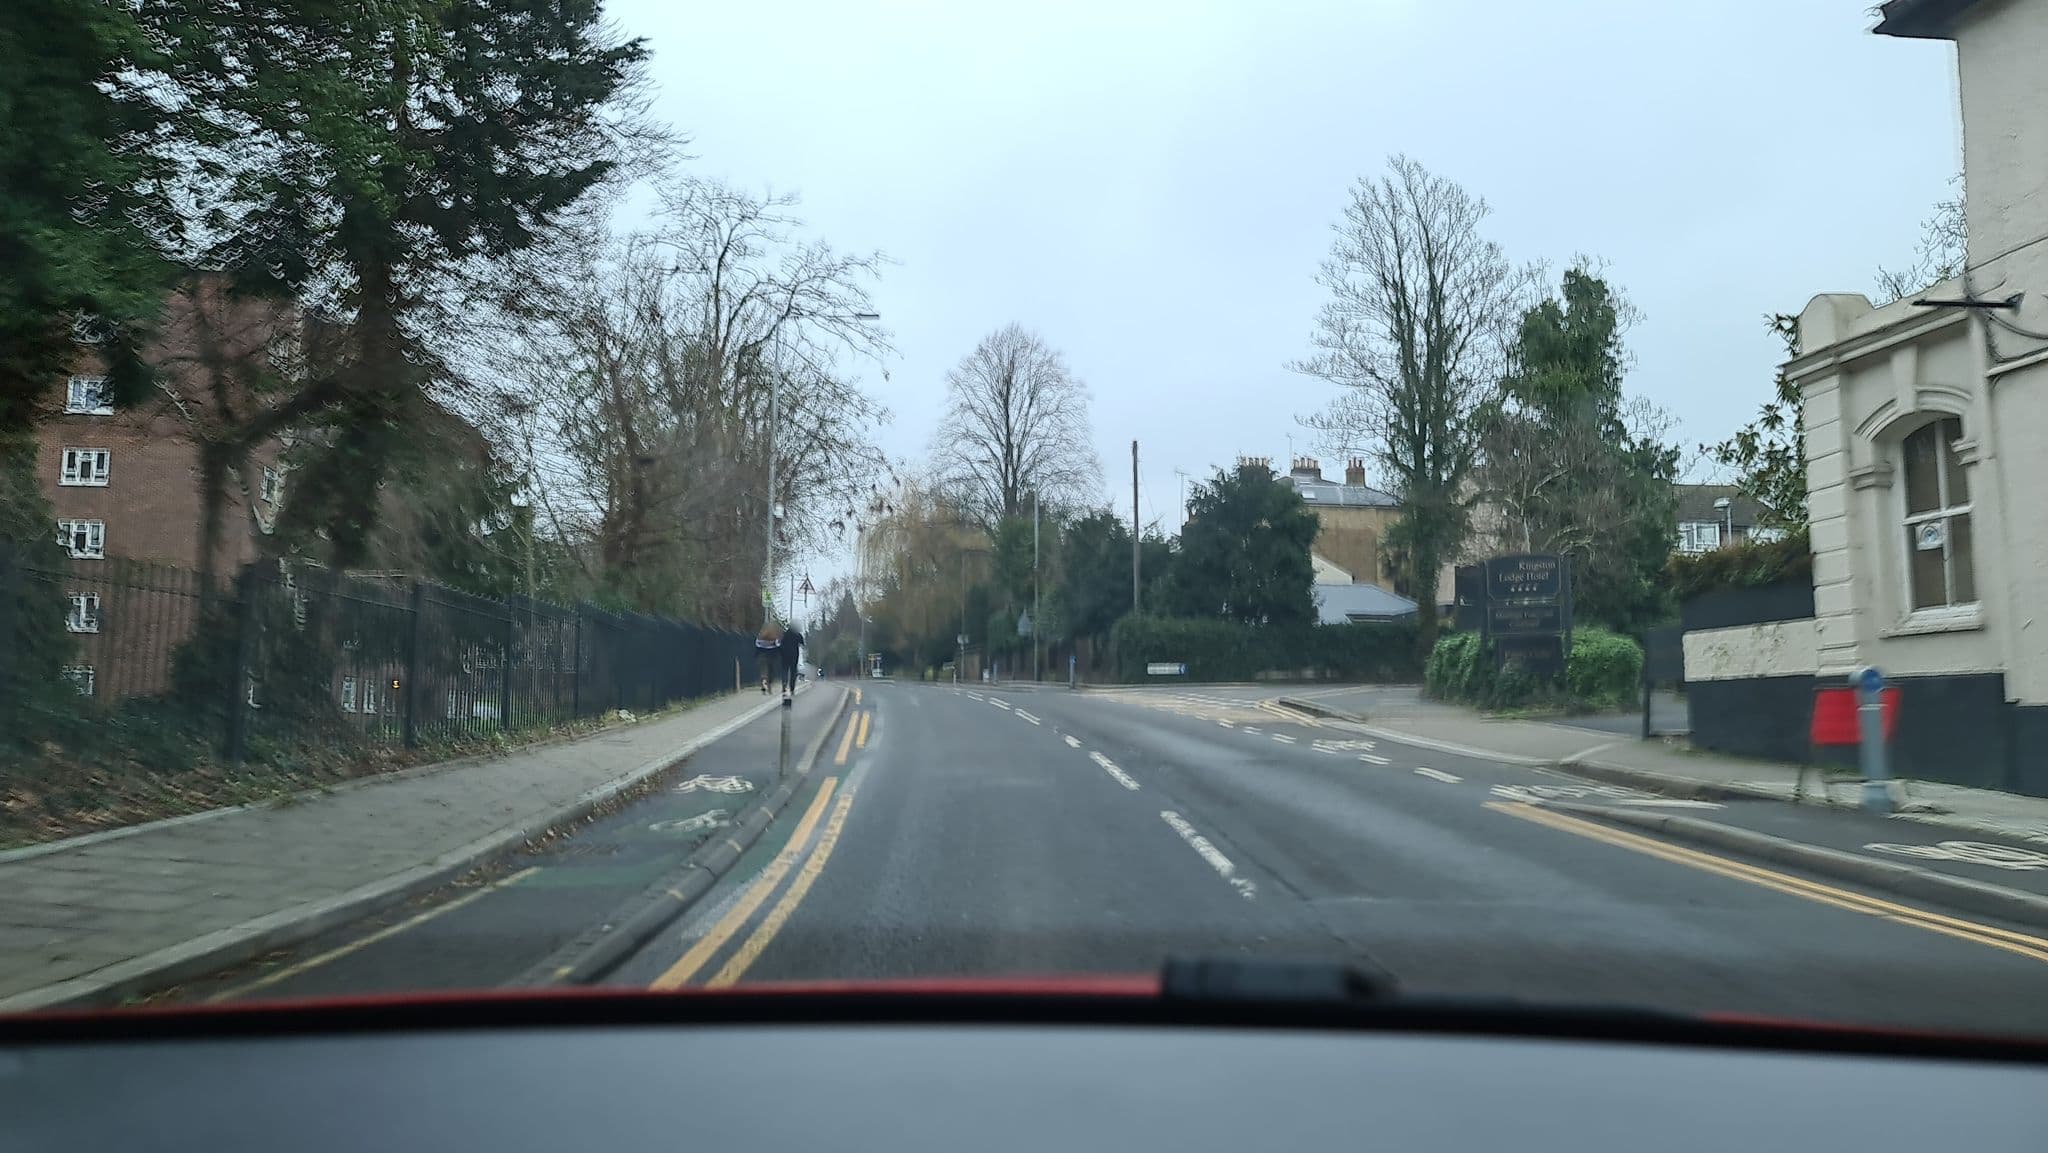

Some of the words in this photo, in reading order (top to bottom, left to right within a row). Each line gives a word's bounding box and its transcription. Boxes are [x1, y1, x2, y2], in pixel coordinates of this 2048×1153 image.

[1518, 560, 1556, 571] Kingston
[1499, 573, 1525, 583] Lodge
[1526, 572, 1549, 582] Hotel
